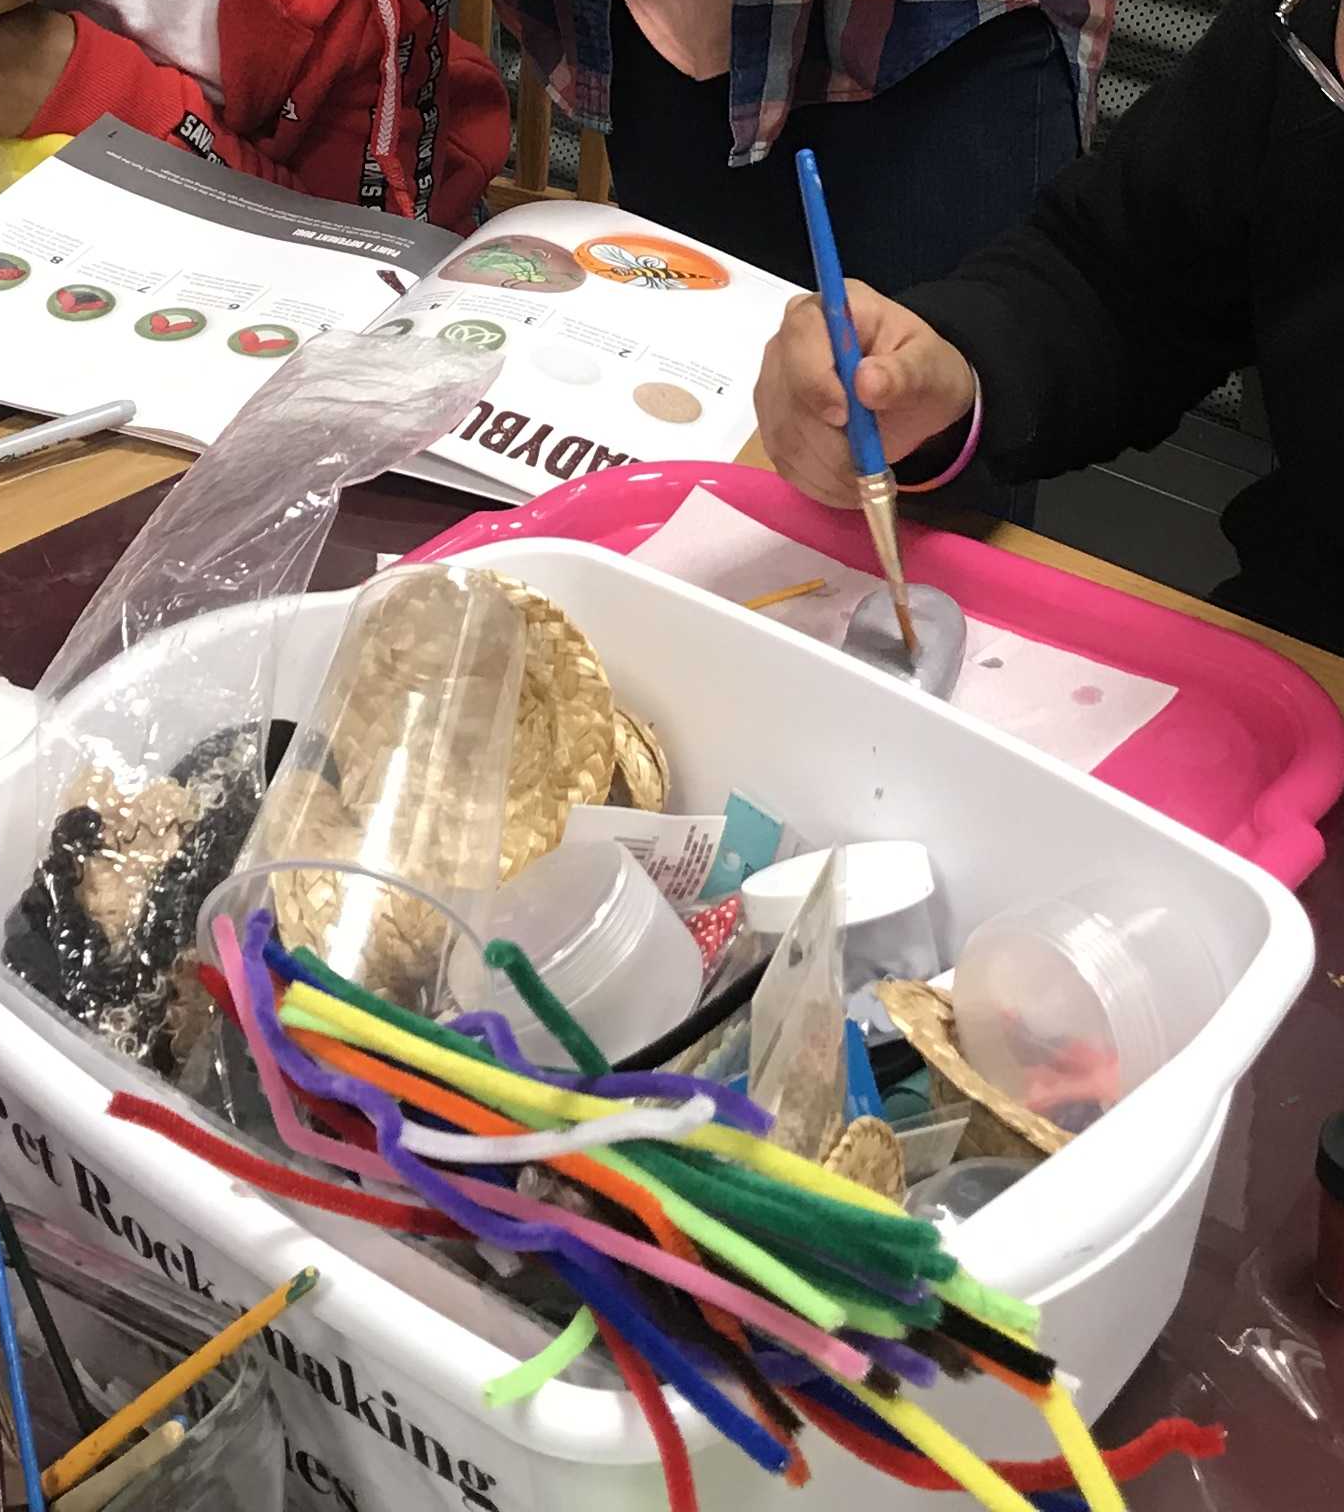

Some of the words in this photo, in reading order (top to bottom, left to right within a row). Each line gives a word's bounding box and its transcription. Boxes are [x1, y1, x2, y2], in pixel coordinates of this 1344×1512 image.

[50, 255, 63, 265] 8
[137, 285, 151, 294] 7
[428, 302, 441, 310] 4
[523, 316, 537, 325] 3
[618, 348, 632, 359] 2
[716, 386, 728, 395] 1
[449, 400, 644, 480] ADYBU
